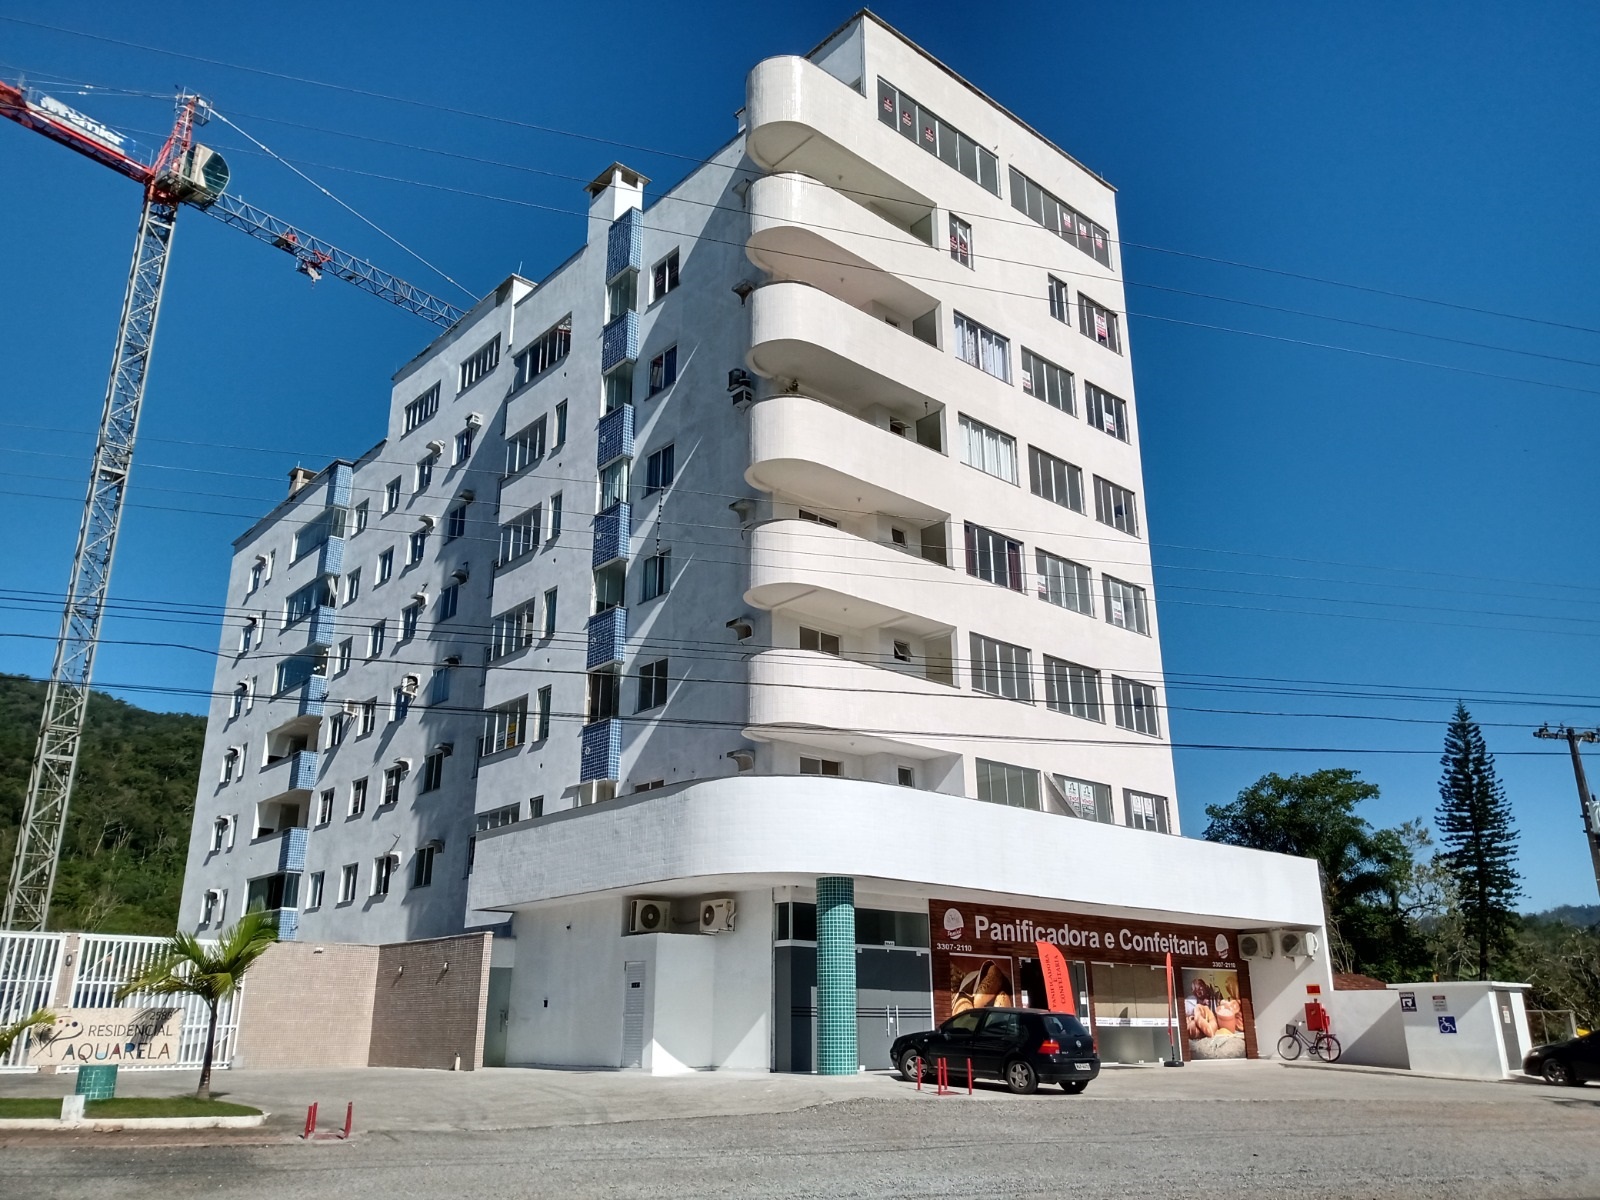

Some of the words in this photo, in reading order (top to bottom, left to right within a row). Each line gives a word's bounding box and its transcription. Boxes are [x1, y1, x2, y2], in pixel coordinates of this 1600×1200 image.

[974, 914, 1100, 948] Panificadora
[1104, 932, 1116, 949] e
[1119, 928, 1209, 956] Confeitaria
[936, 942, 973, 952] 3307-2110
[88, 1024, 173, 1036] RESIDENCIAL
[62, 1042, 170, 1063] AQUARELA
